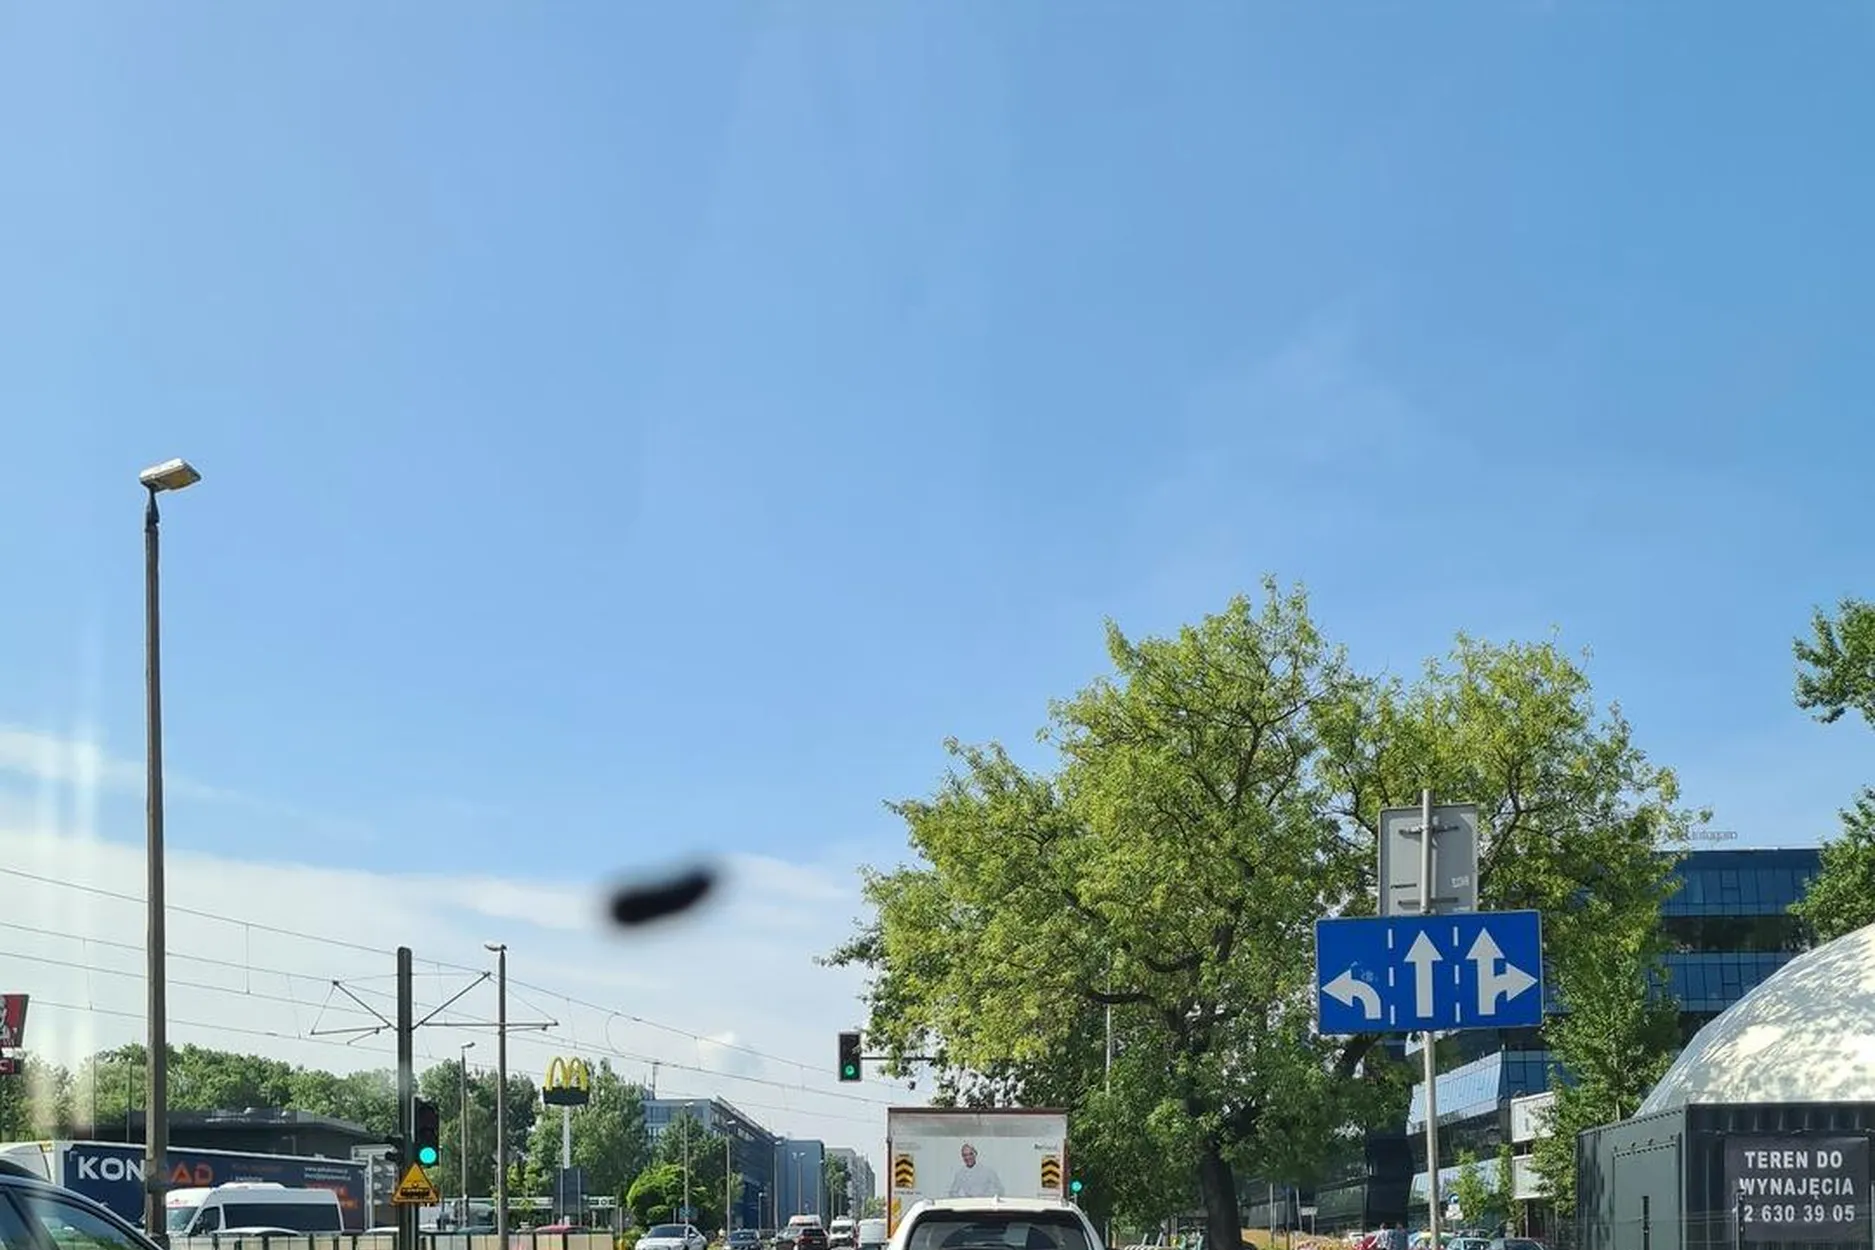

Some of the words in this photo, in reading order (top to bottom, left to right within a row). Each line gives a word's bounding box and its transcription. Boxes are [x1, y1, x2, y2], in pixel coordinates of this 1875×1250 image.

[1744, 1151, 1808, 1169] TEREN
[1816, 1151, 1843, 1169] DO
[77, 1156, 214, 1186] KONAD
[1739, 1178, 1854, 1200] WYNAJĘCIA
[1761, 1204, 1795, 1222] 630
[1803, 1204, 1825, 1222] 39
[1832, 1204, 1855, 1222] 05
